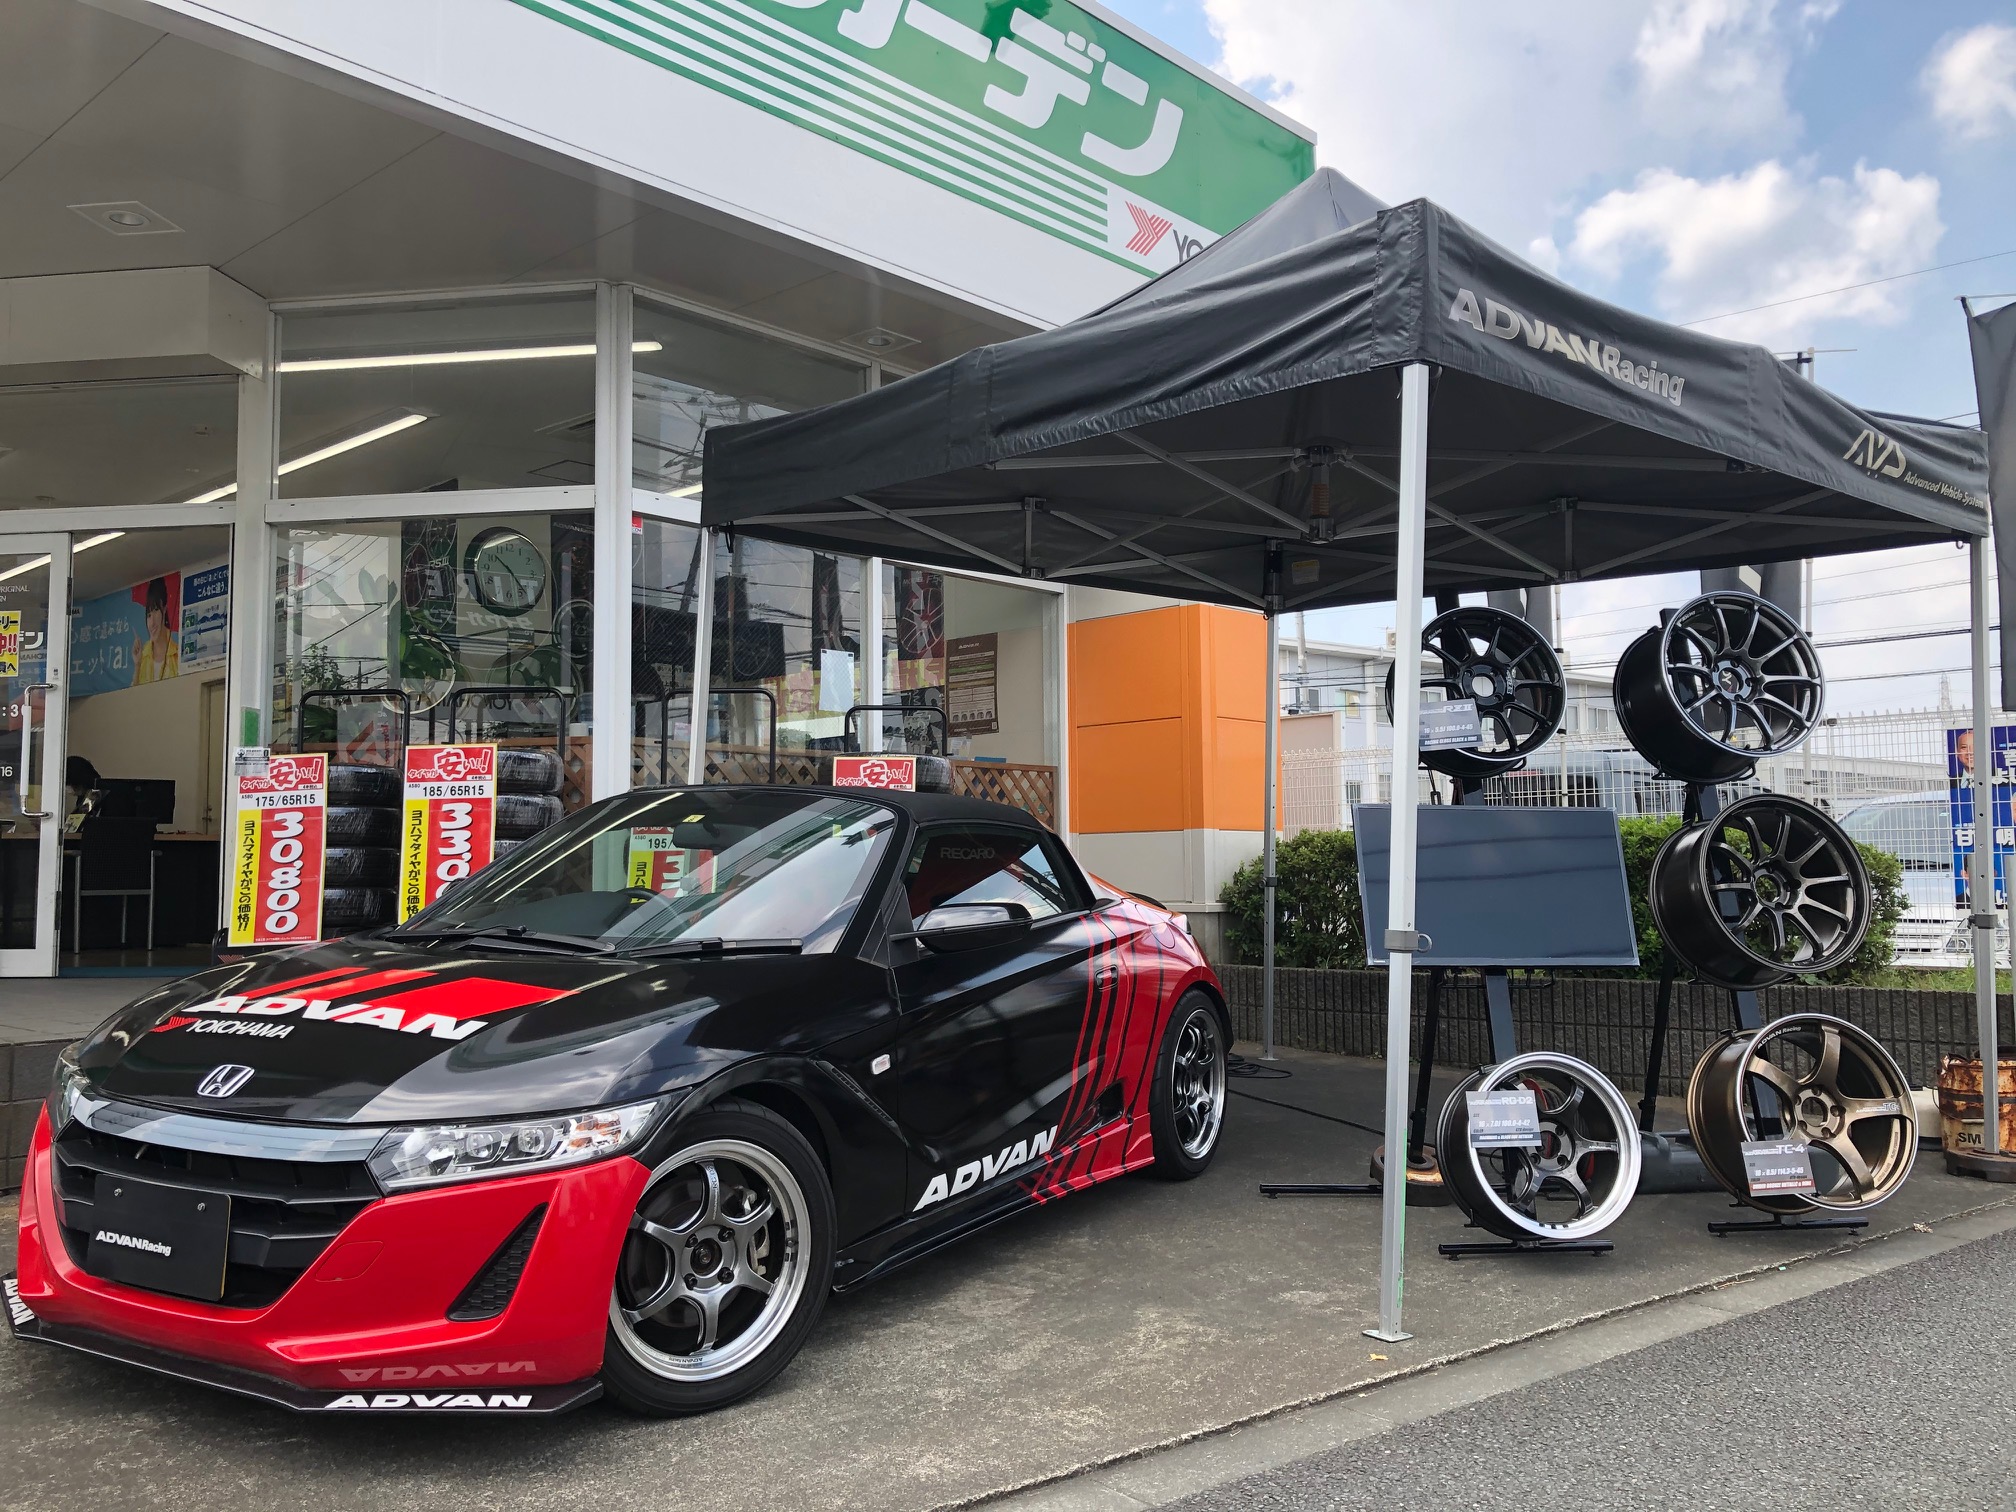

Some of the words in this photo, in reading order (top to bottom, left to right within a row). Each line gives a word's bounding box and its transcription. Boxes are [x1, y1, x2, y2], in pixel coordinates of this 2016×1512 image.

[1904, 471, 1941, 493] Advanced
[1940, 482, 1963, 502] Vehicle
[1962, 491, 1985, 509] System
[256, 794, 316, 807] 175/65R15
[423, 785, 484, 797] 185/65R15
[940, 847, 995, 859] RECARO
[265, 811, 304, 934] 30,800
[181, 996, 489, 1041] ADVAN
[185, 1019, 295, 1039] YOKOHAMA
[1757, 1029, 1782, 1050] ADVAN
[1957, 1132, 1982, 1145] SM
[912, 1125, 1058, 1212] ADVAN
[2, 1278, 36, 1326] ADVAN
[324, 1394, 533, 1409] ADVAN
